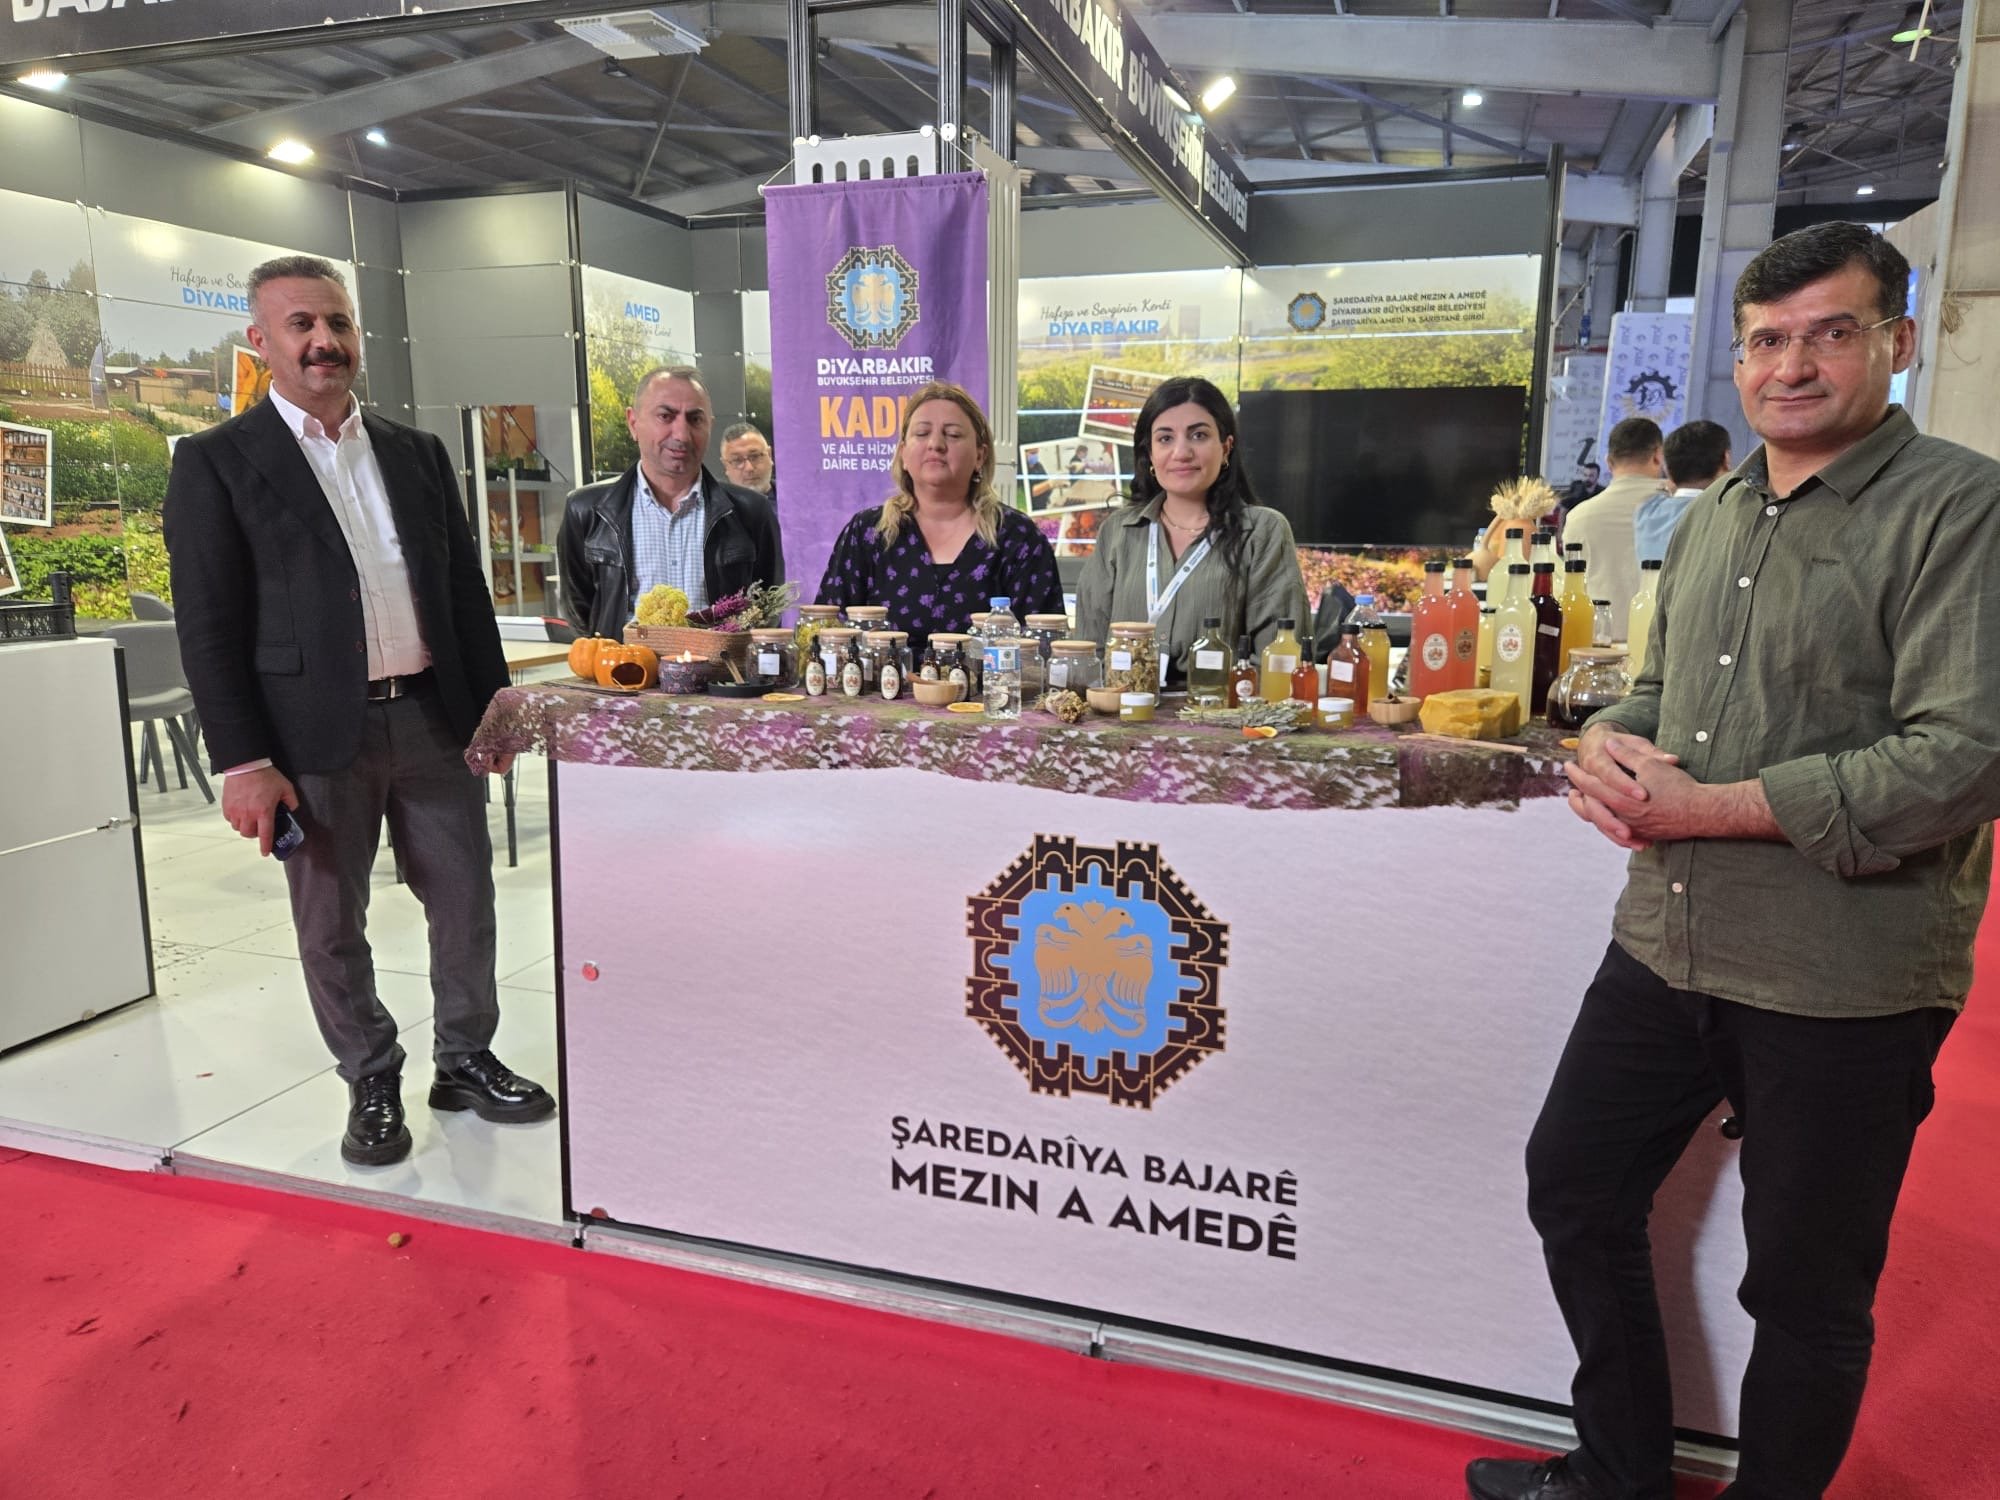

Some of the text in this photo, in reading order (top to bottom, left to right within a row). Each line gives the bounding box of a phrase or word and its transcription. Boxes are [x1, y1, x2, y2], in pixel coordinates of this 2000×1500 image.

[1204, 151, 1248, 232] BELEDİYESİ
[624, 301, 660, 323] AMED
[1092, 302, 1137, 318] Sevginin
[1142, 299, 1172, 313] Kenti
[1049, 320, 1159, 336] DİYARBAKIR
[818, 377, 878, 386] BÜYÜKŞEHİR
[822, 444, 836, 454] VE
[839, 441, 864, 455] AİLE
[823, 457, 858, 470] DAİRE
[891, 1115, 1298, 1207] ŞAREDARÎYA BAJARÊ
[891, 1157, 1298, 1261] MEZIN A AMEDÊ
